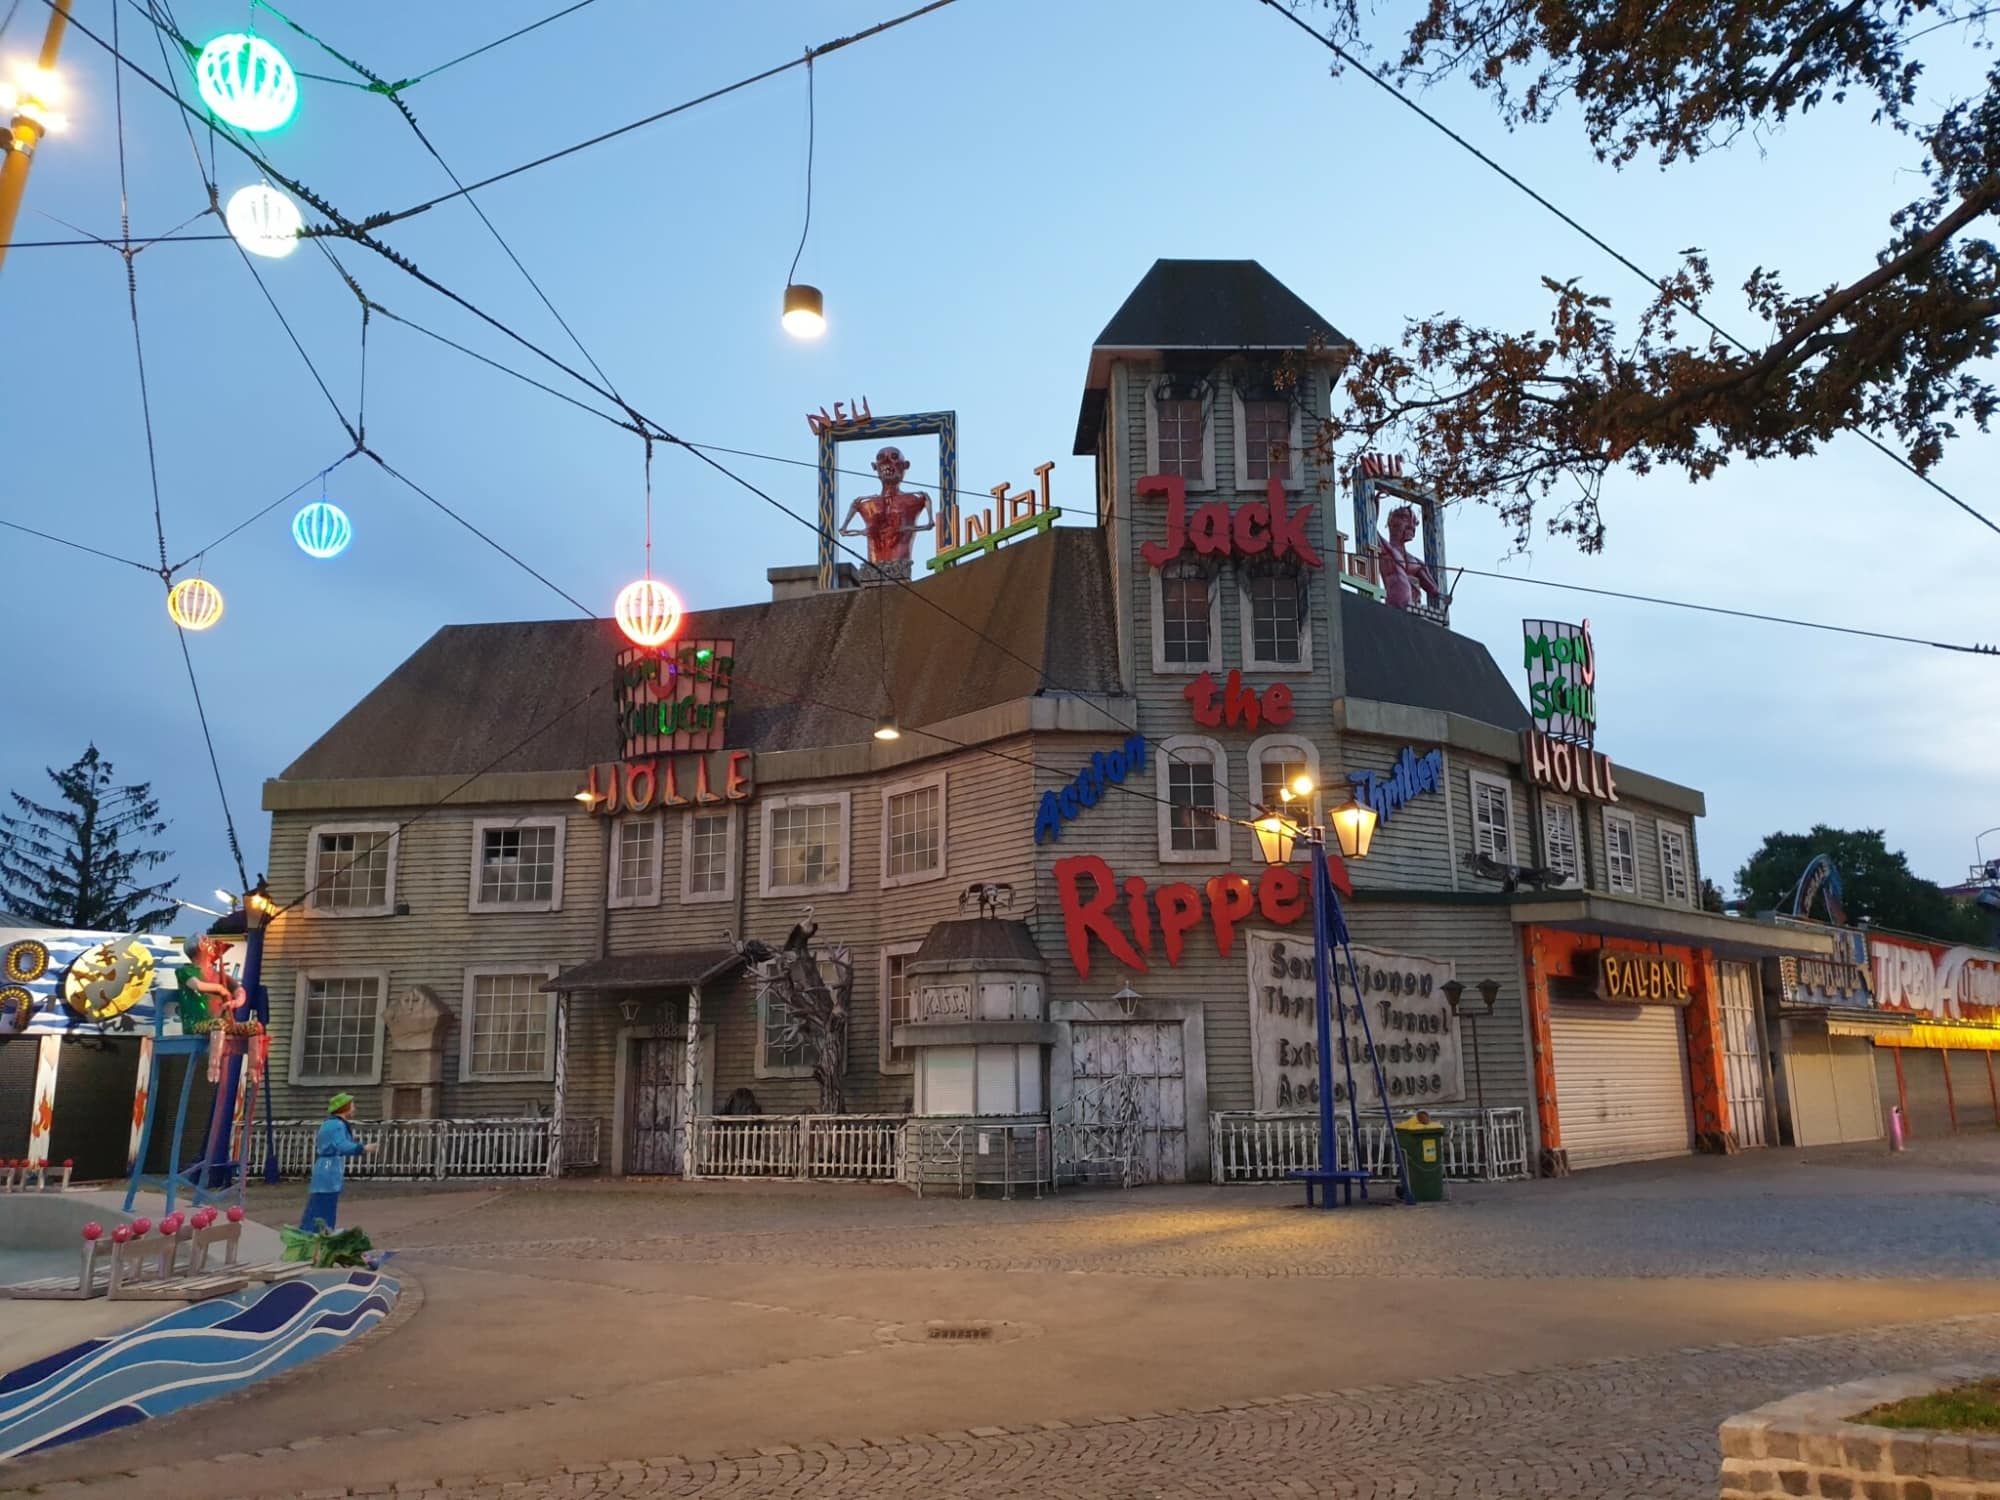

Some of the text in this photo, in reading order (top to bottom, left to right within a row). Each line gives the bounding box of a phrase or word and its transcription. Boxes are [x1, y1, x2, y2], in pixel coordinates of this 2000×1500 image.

[806, 395, 871, 435] NEU
[935, 460, 1055, 555] UNTOT
[1136, 474, 1323, 568] Jack
[1184, 669, 1296, 731] the
[1034, 733, 1145, 846] Action
[1345, 745, 1442, 829] Thriller
[925, 993, 969, 1016] KASSA
[1605, 956, 1688, 1000] BALLBALL
[1376, 1000, 1449, 1034] Tunnel
[1276, 1073, 1358, 1108] Acton
